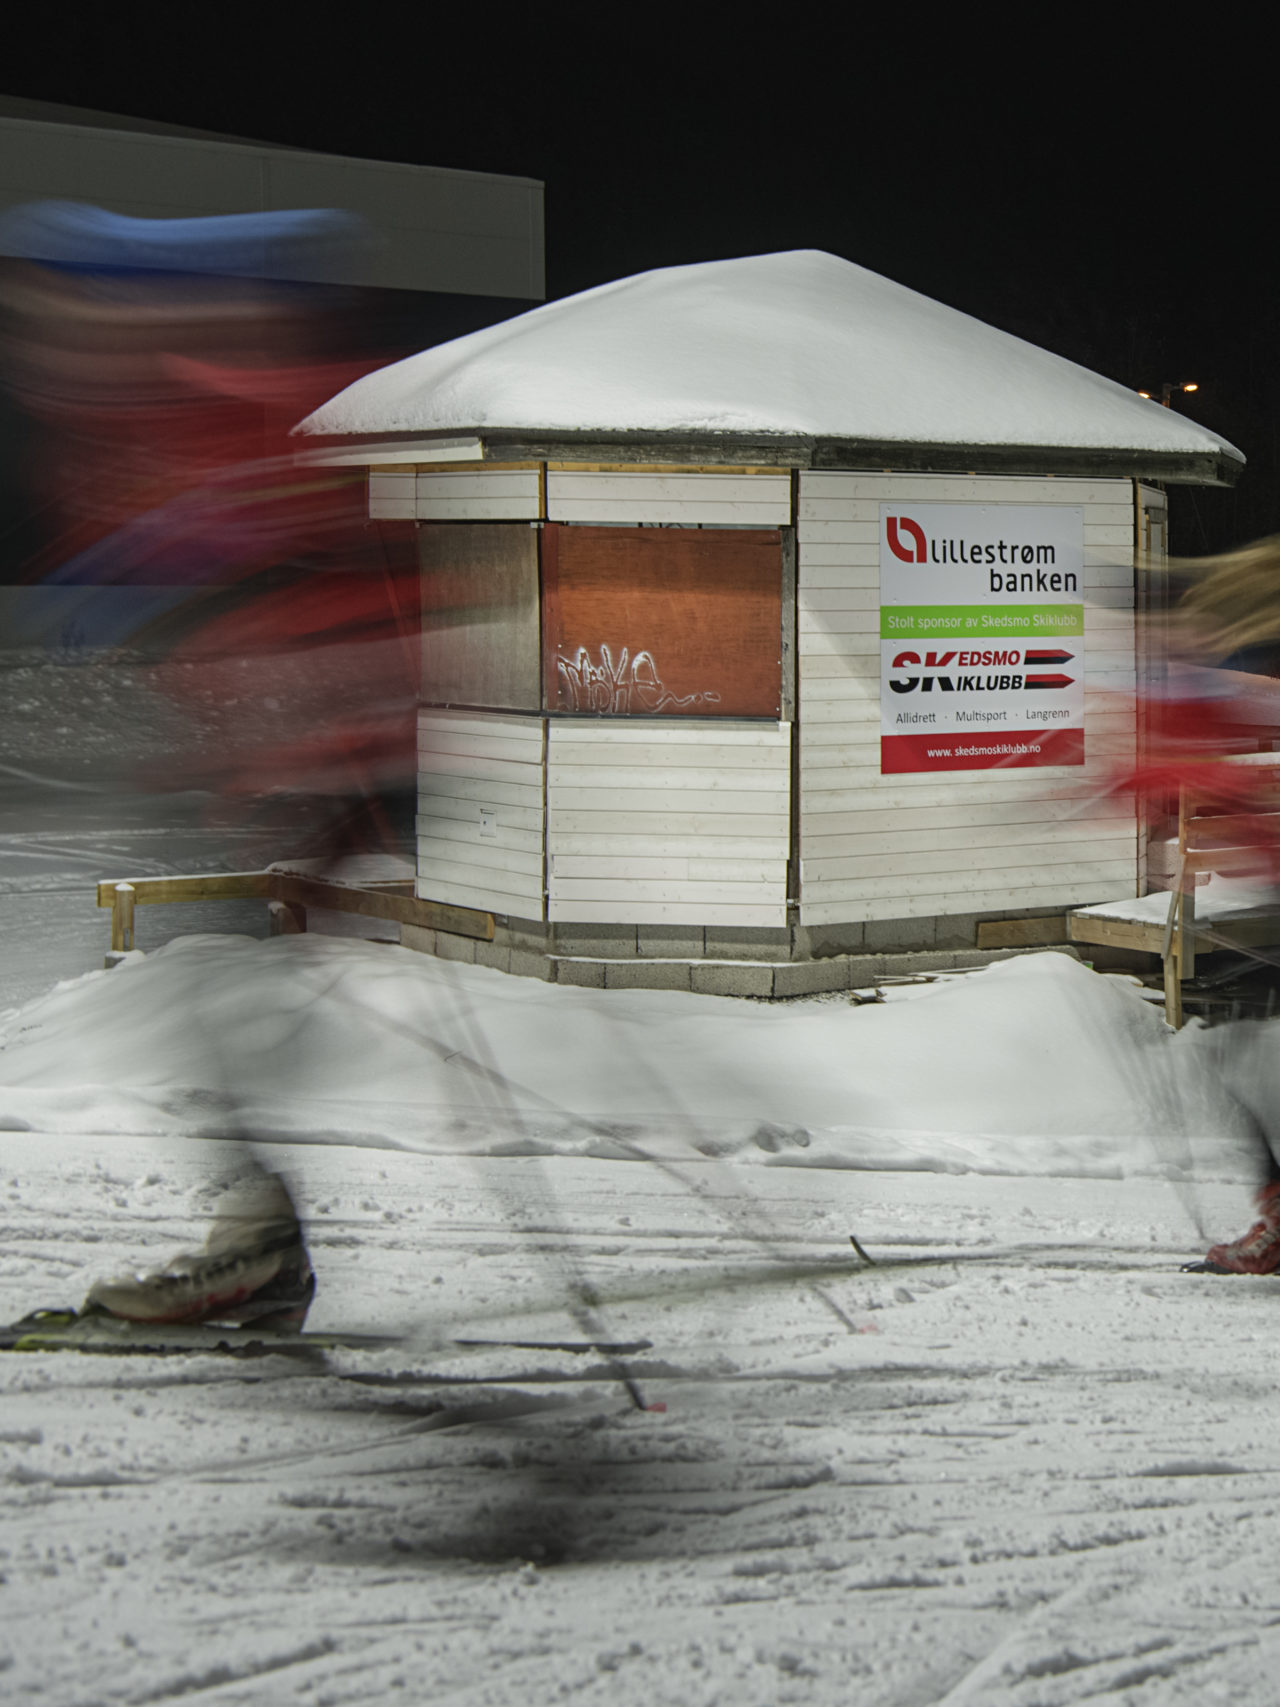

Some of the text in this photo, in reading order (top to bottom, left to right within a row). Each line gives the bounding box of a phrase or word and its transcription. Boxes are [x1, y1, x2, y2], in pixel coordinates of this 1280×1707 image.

[931, 540, 1056, 564] lillestrøm
[989, 569, 1078, 592] banken
[887, 614, 1078, 630] Stolt sponsor av Skedsmo Skiklubb
[895, 709, 1070, 724] Allidrett Multisport Langrenn
